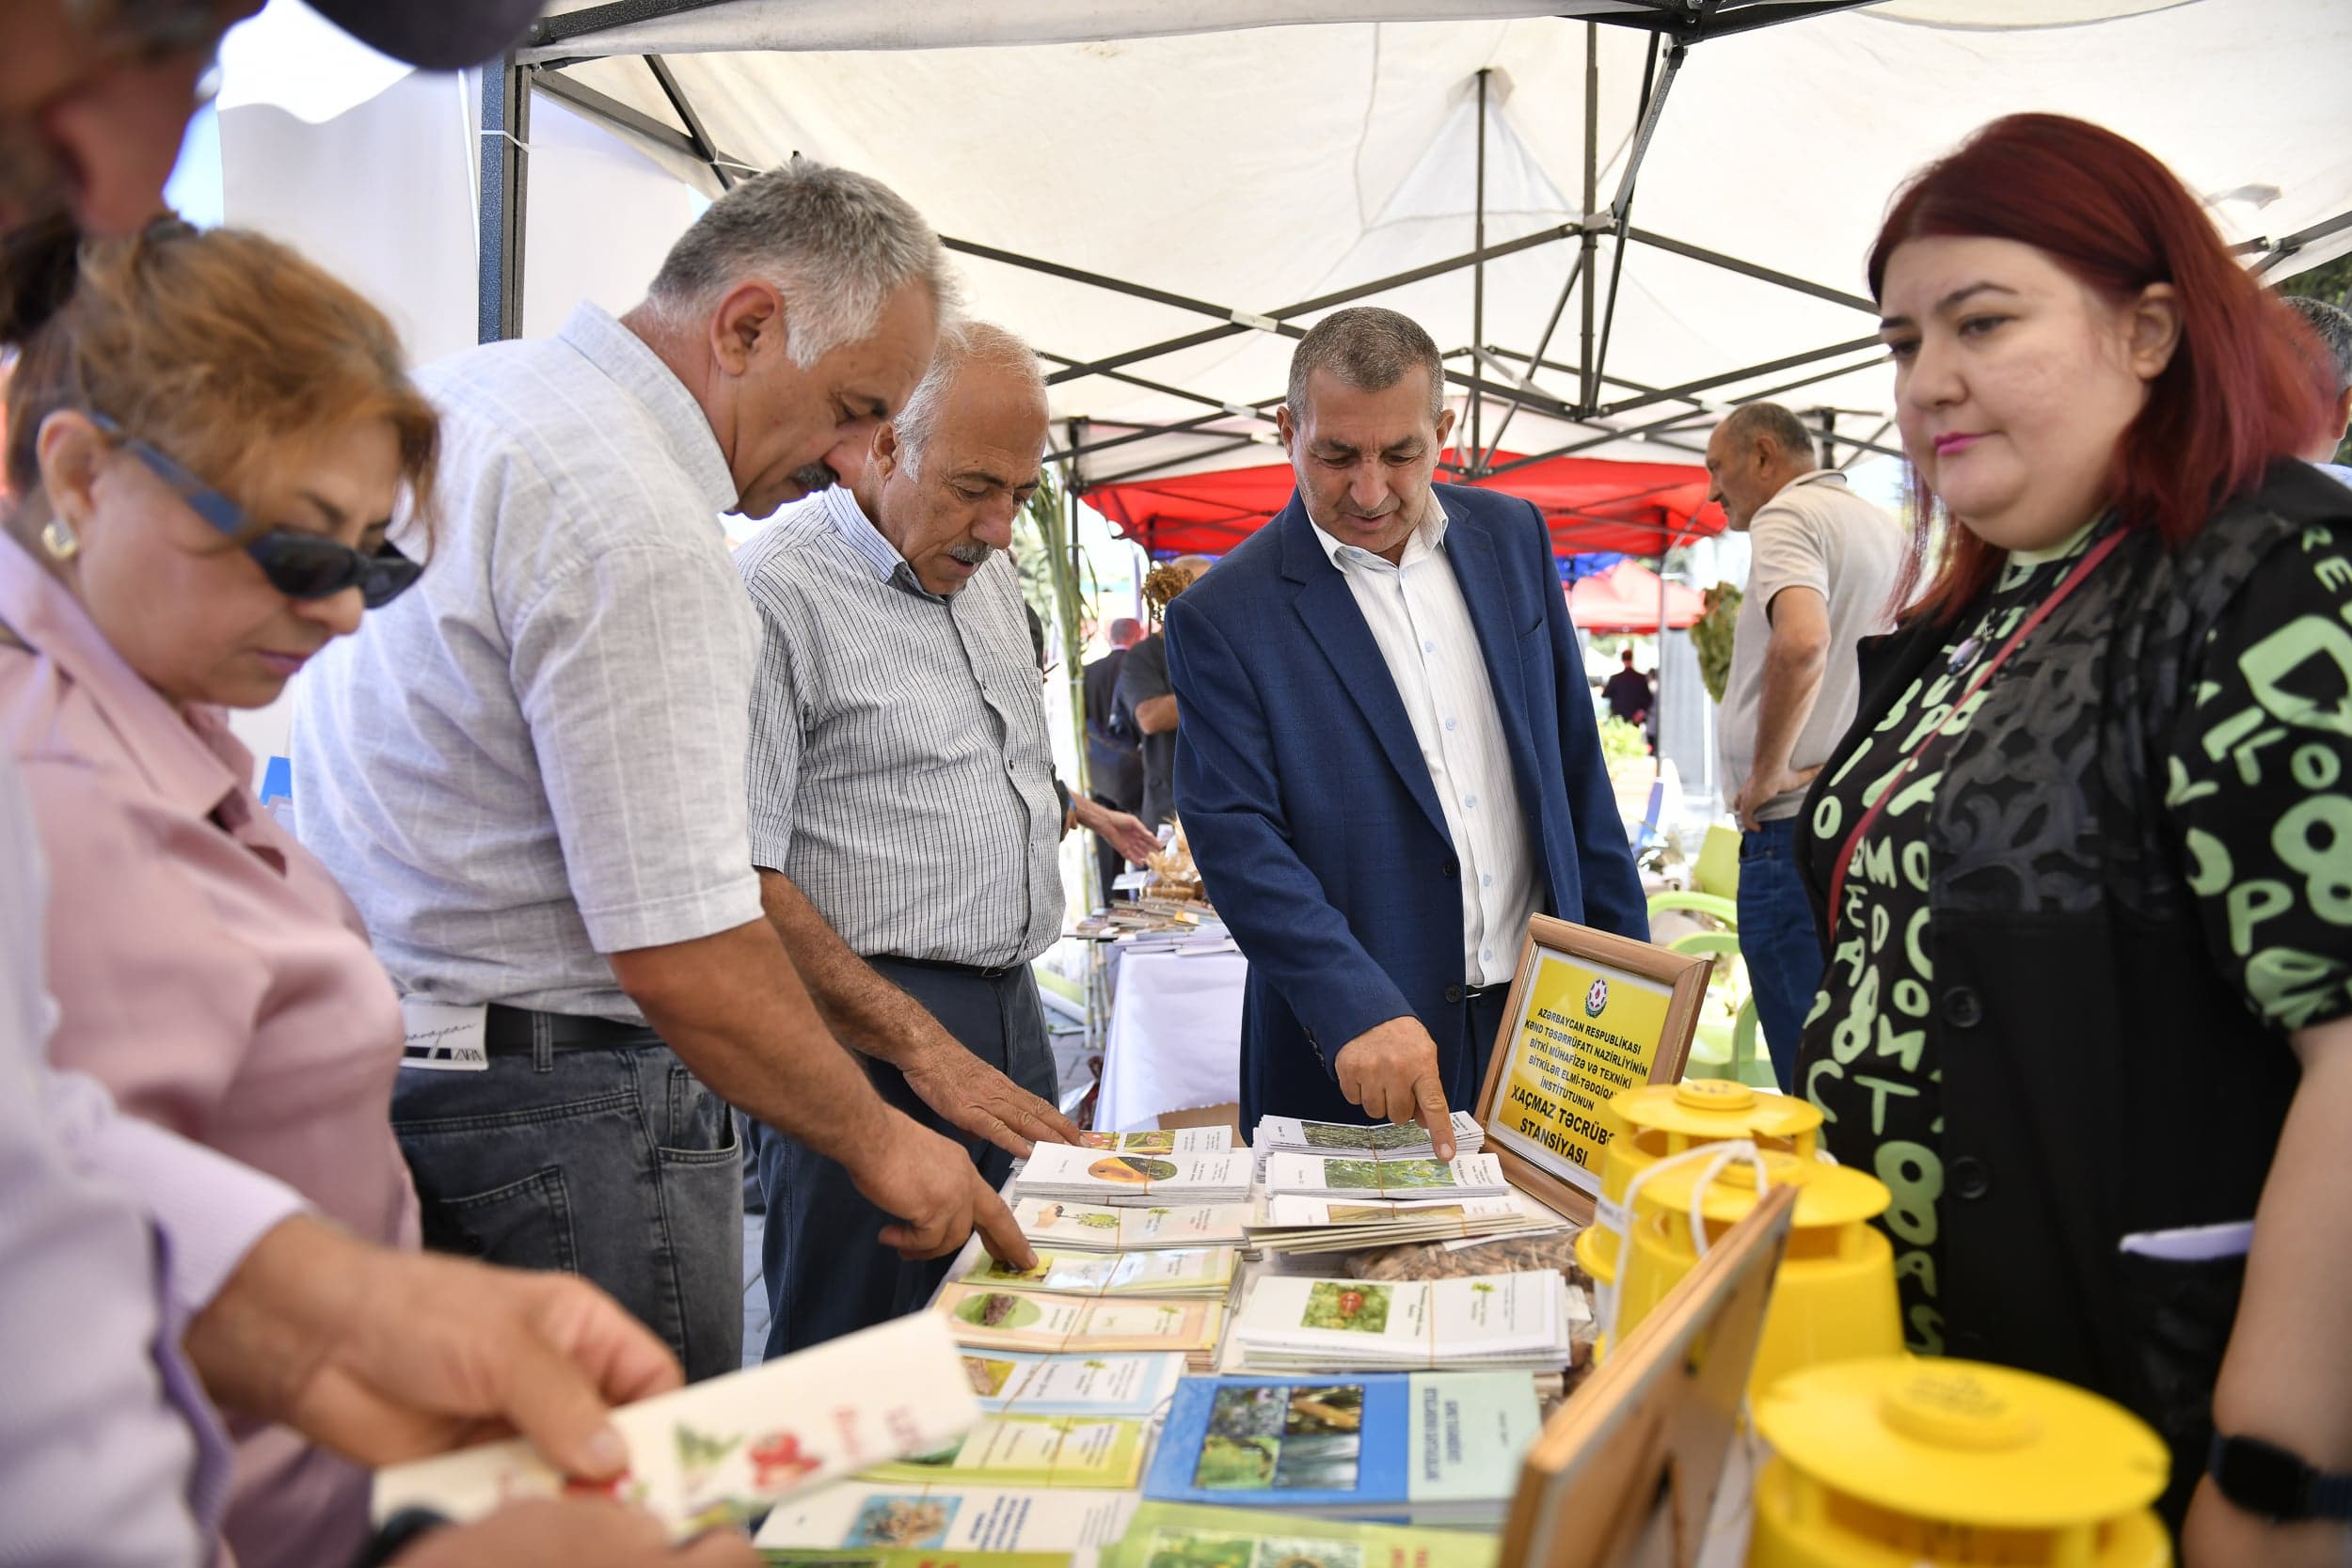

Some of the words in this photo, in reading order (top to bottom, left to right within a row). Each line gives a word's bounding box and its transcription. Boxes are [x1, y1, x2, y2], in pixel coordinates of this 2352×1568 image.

[1524, 1019, 1544, 1034] KƏND
[1545, 1026, 1593, 1054] TƏSƏRRÜFATI
[1594, 1046, 1648, 1077] NAZİRLİYİNİN
[1537, 1007, 1584, 1033] AZƏRBAYCAN
[1585, 1025, 1641, 1055] RESPUBLİKASI
[1528, 1055, 1561, 1077] BİTKİLƏR
[1530, 1037, 1549, 1053] BİTKİ
[1549, 1045, 1585, 1069] MÜHAFİZƏ
[1587, 1062, 1597, 1075] VƏ
[1599, 1068, 1632, 1090] TEXNİKİ
[1511, 1085, 1557, 1119] XAÇMAZ
[1540, 1076, 1595, 1111] İNSTİTUTUNUN
[1520, 1117, 1588, 1166] STANSİYASI
